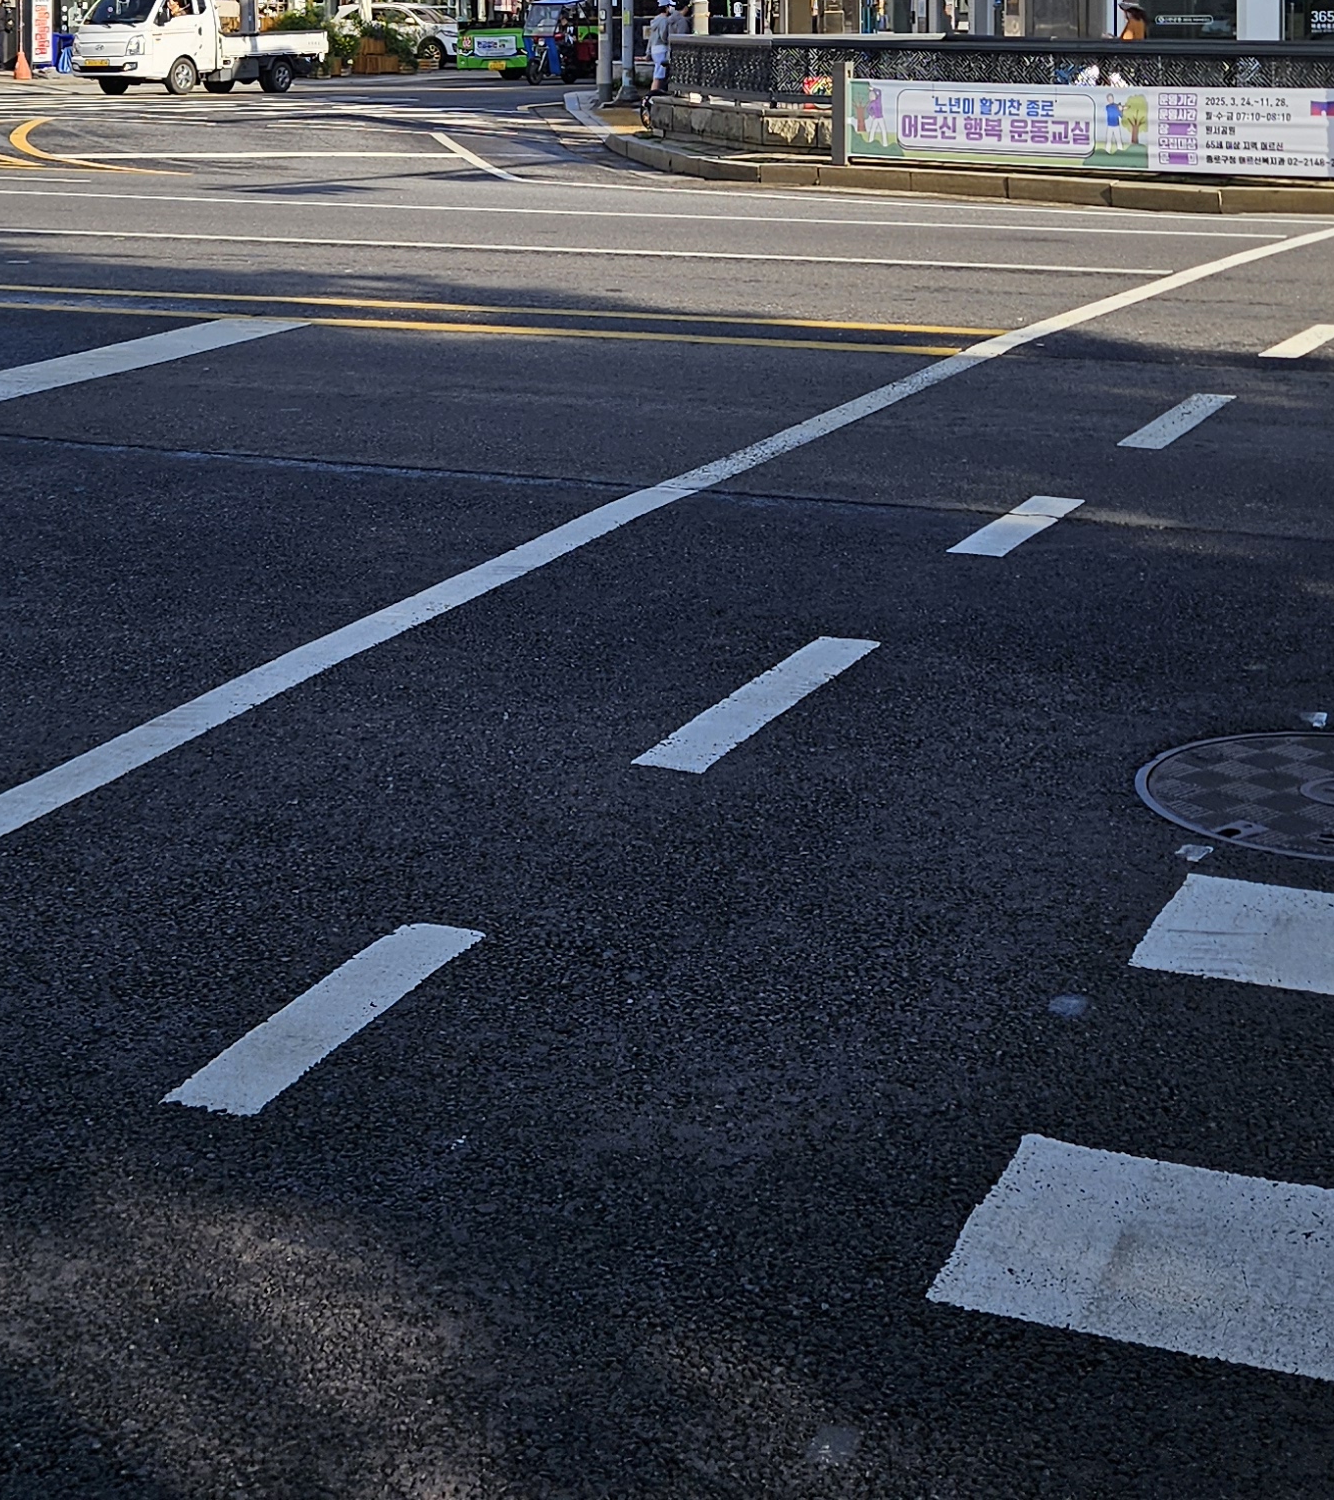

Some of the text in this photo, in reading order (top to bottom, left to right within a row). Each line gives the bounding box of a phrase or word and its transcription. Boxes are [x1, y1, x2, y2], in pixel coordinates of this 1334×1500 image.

[980, 97, 1022, 116] 활기찬
[1205, 97, 1229, 106] 2025.
[1235, 112, 1292, 122] 07:10~08:10
[901, 114, 1090, 145] 어르신 행복 운동교실
